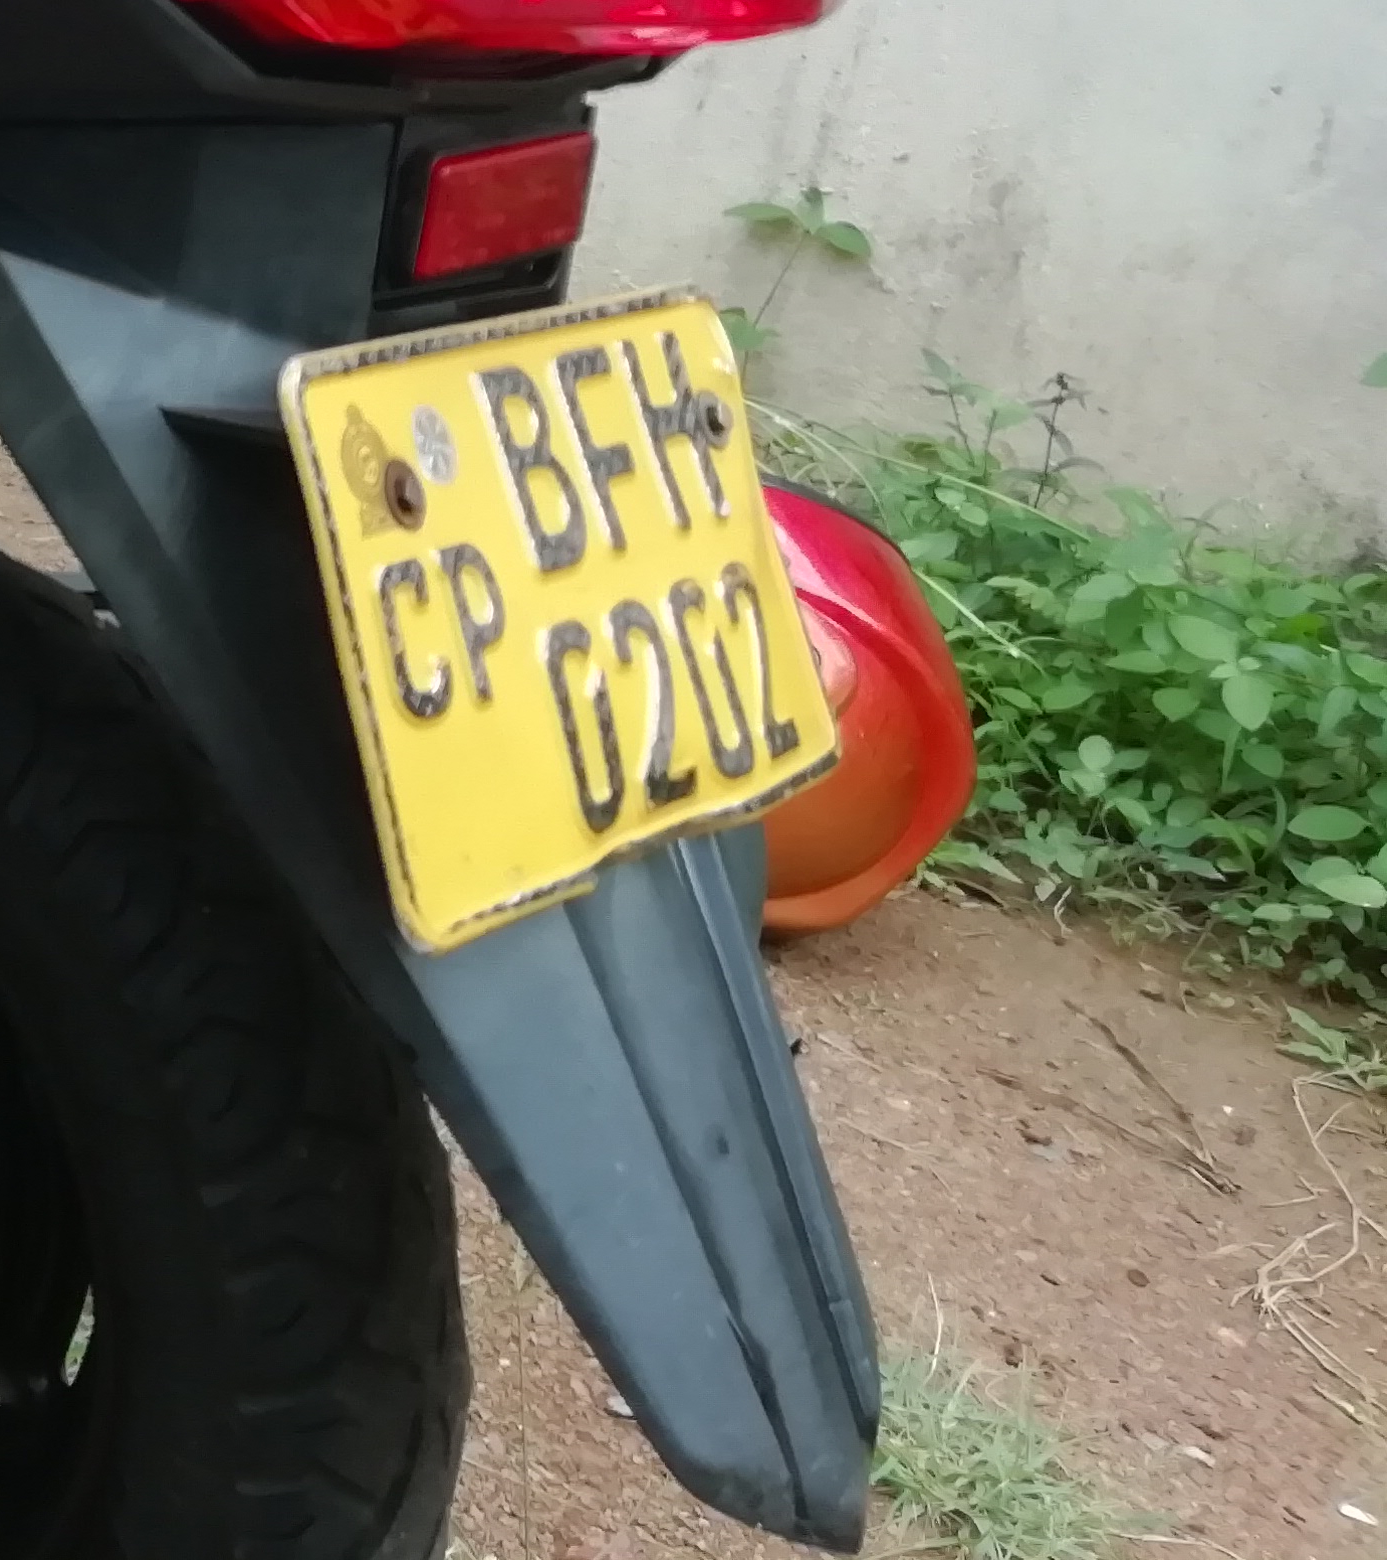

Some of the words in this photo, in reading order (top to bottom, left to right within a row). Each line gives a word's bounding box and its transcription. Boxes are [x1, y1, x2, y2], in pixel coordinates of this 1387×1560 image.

[471, 331, 730, 574] BFH
[374, 542, 505, 719] CP
[539, 561, 799, 834] 0202
